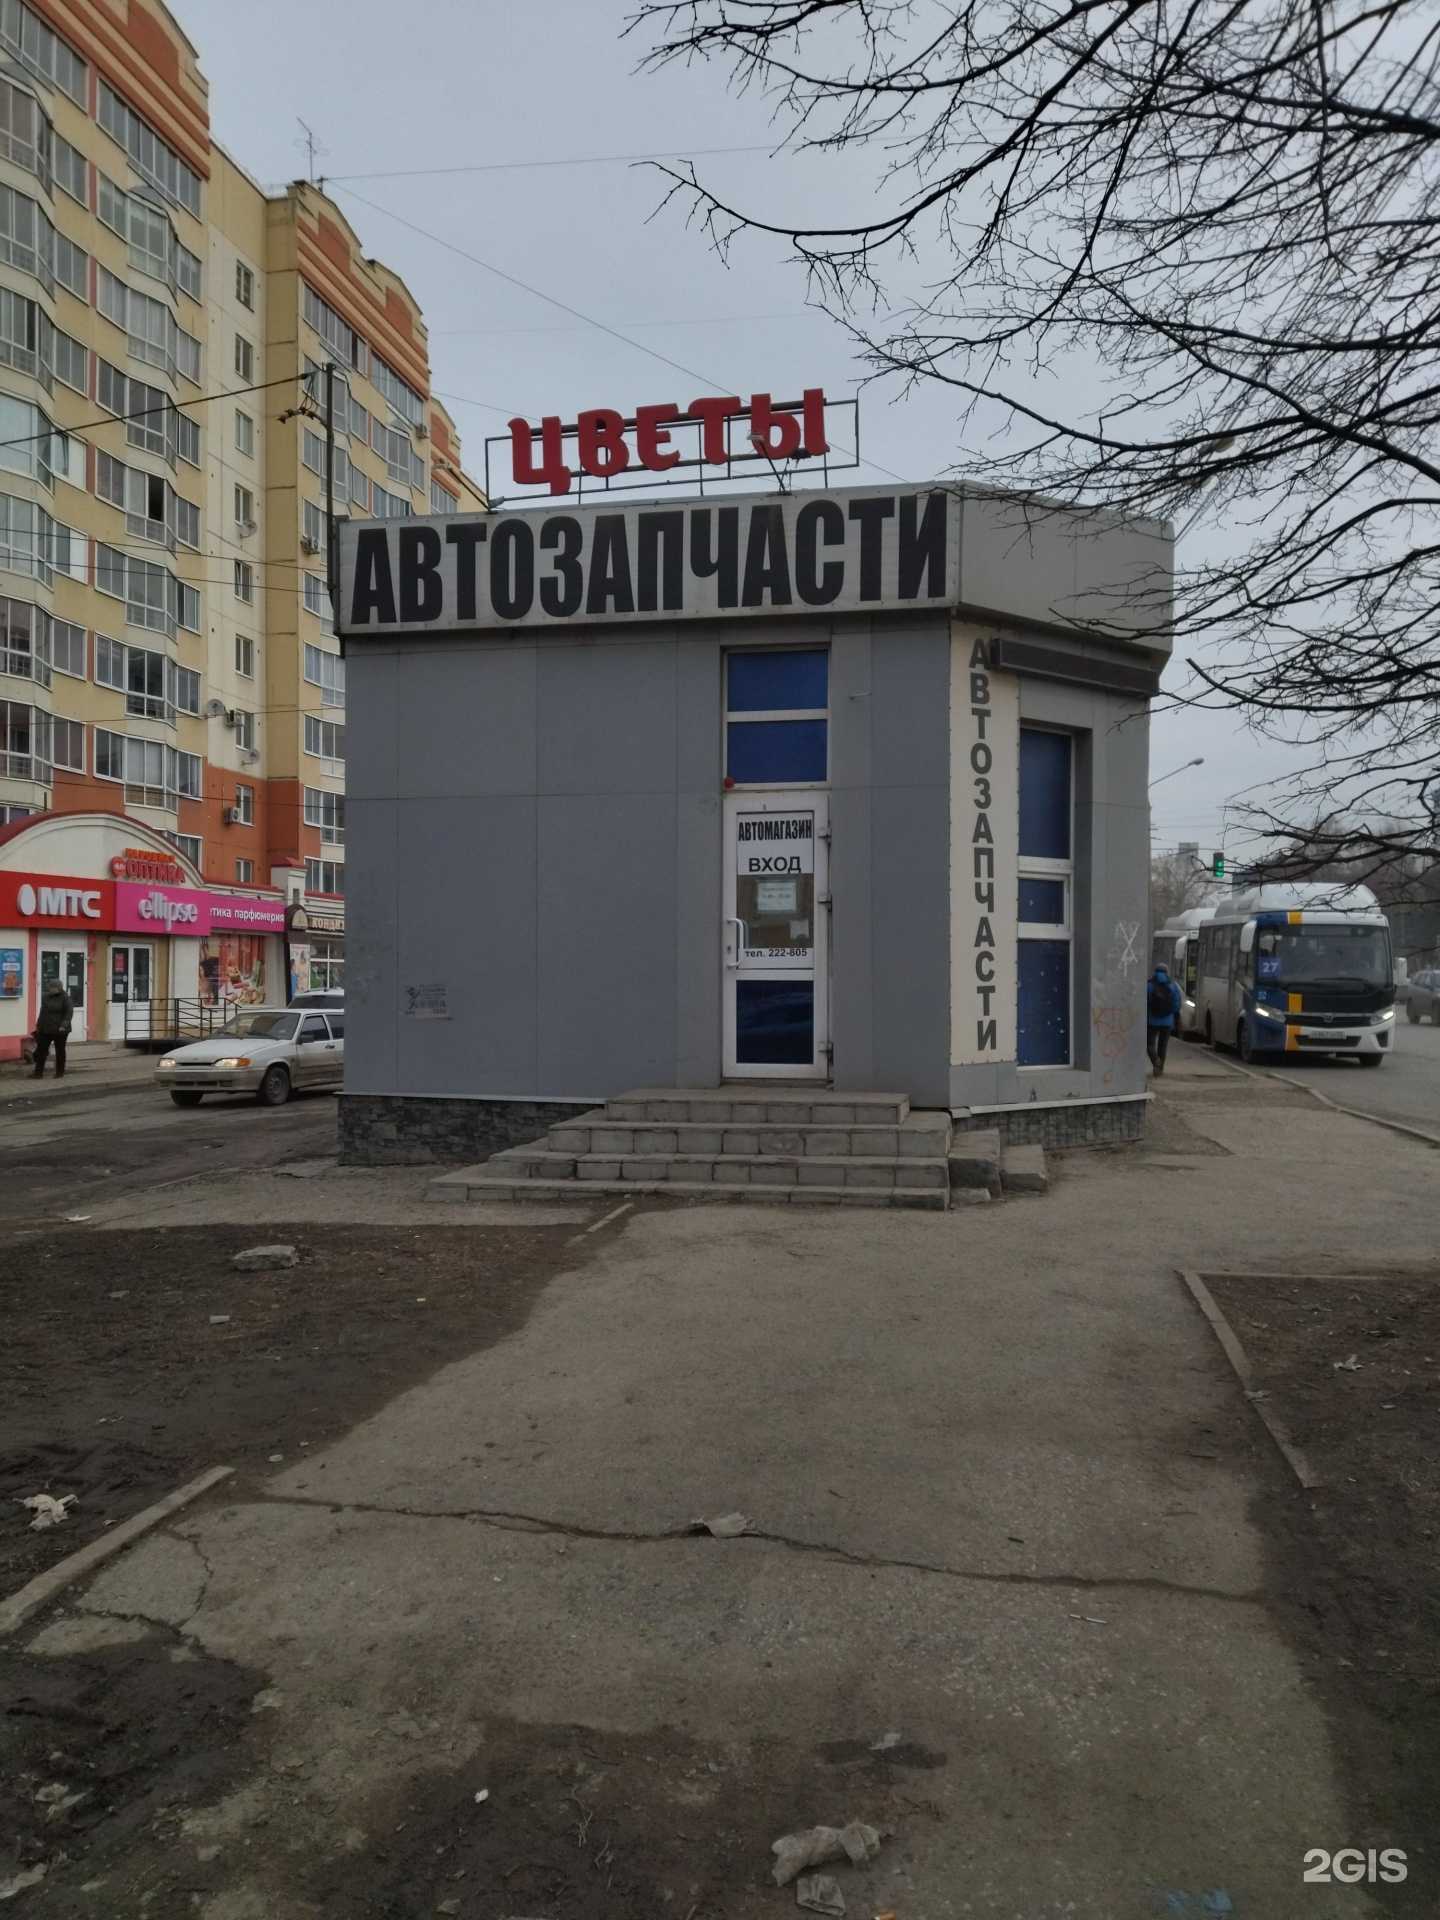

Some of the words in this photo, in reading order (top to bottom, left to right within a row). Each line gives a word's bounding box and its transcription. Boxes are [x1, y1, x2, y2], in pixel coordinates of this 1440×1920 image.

[507, 388, 830, 496] ЦВЕТЫ
[350, 492, 947, 625] АВТОЗАПЧАСТИ
[738, 820, 812, 841] АВТОМАГАЗИН
[969, 637, 997, 1051] АВТОЗАПЧАСТИ
[749, 856, 802, 873] ВХОД
[37, 886, 101, 918] МТС
[138, 891, 198, 932] ellipse
[1262, 962, 1279, 973] 27
